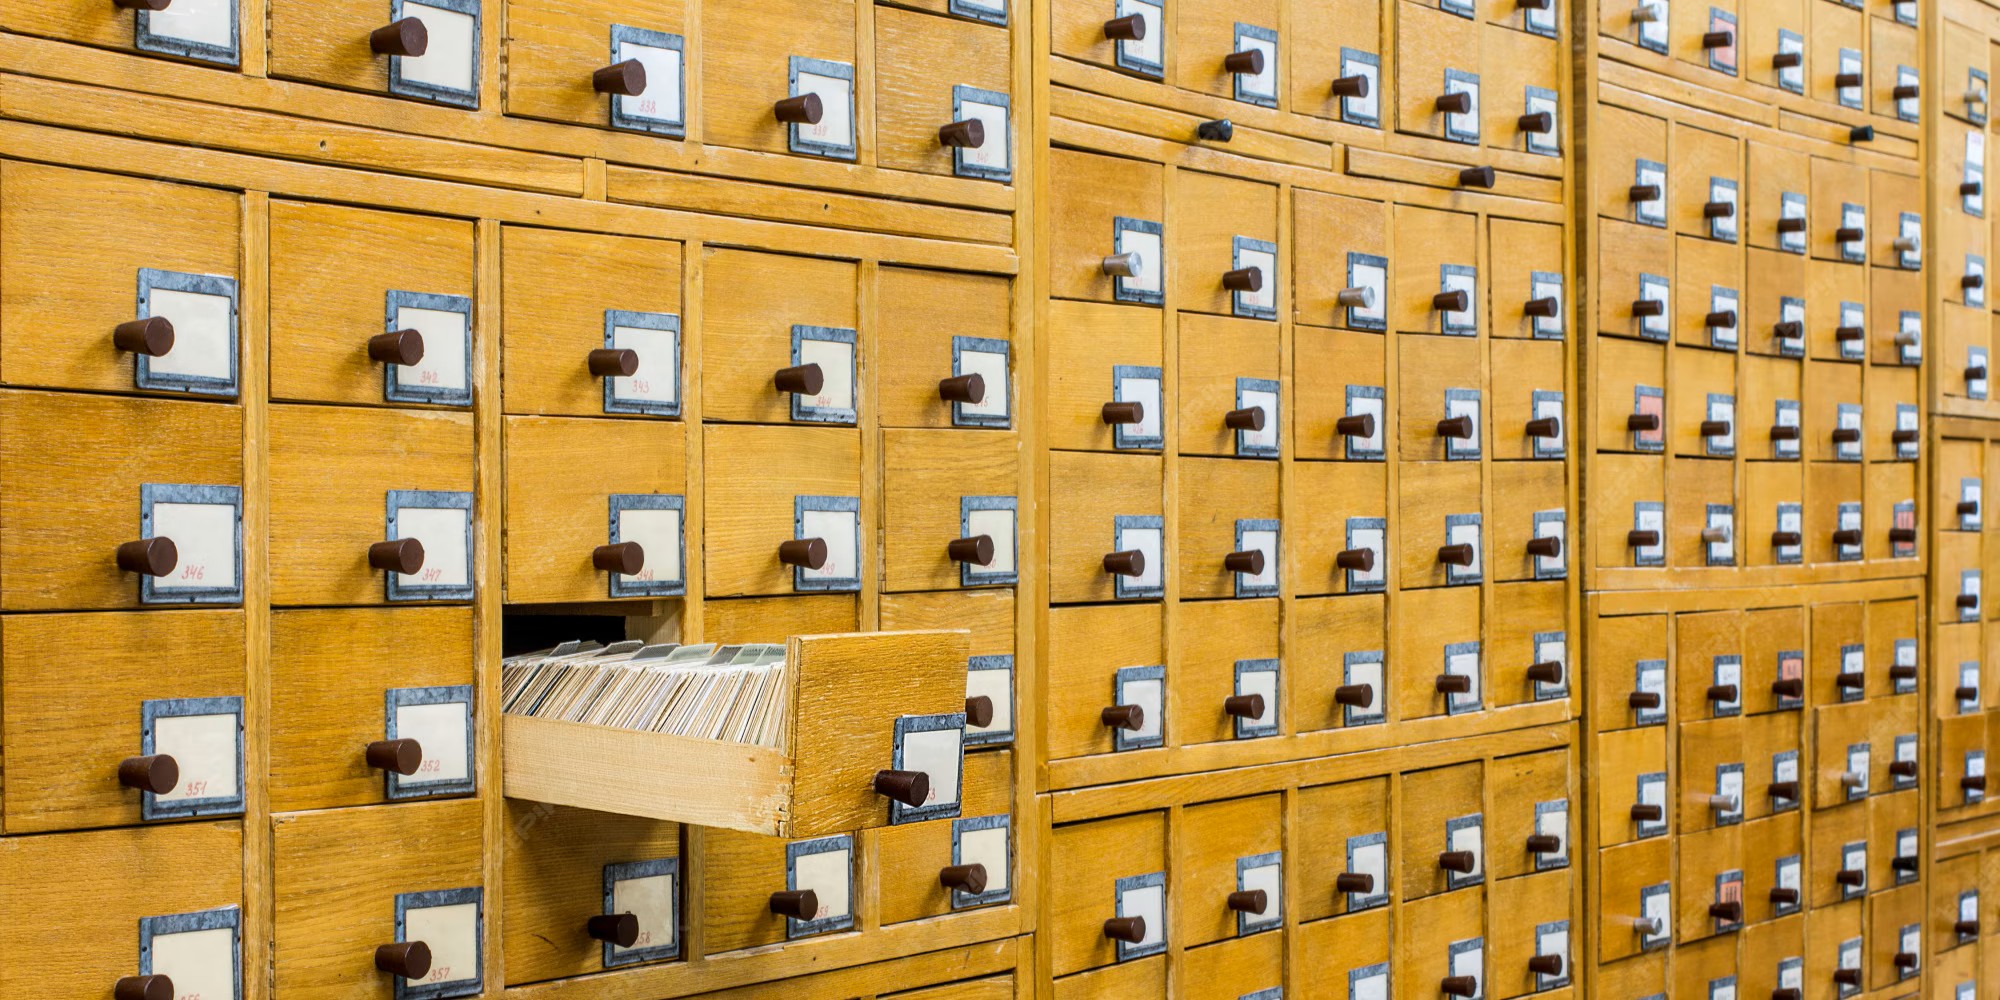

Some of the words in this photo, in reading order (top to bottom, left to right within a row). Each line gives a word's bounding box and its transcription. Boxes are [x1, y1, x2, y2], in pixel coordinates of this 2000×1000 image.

[639, 99, 656, 114] 338
[420, 371, 438, 384] 342
[632, 380, 649, 394] 343
[815, 396, 831, 407] 344
[182, 565, 205, 580] 346
[422, 568, 441, 582] 347
[637, 569, 654, 581] 348
[421, 760, 440, 772] 352
[186, 781, 207, 796] 351
[430, 967, 450, 982] 357
